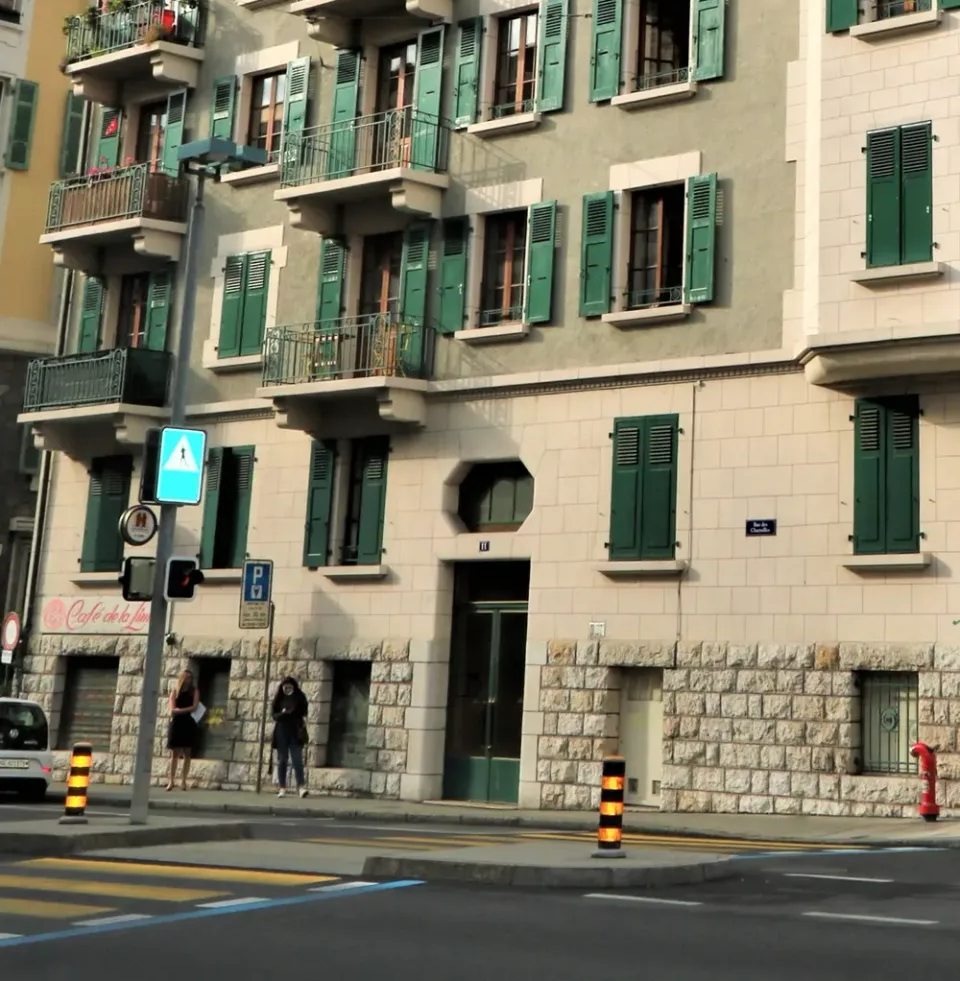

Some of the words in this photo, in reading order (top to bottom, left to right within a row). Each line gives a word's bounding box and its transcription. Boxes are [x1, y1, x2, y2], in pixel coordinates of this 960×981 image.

[252, 565, 264, 585] P
[66, 600, 105, 631] Café
[104, 604, 118, 623] de
[117, 603, 131, 623] la
